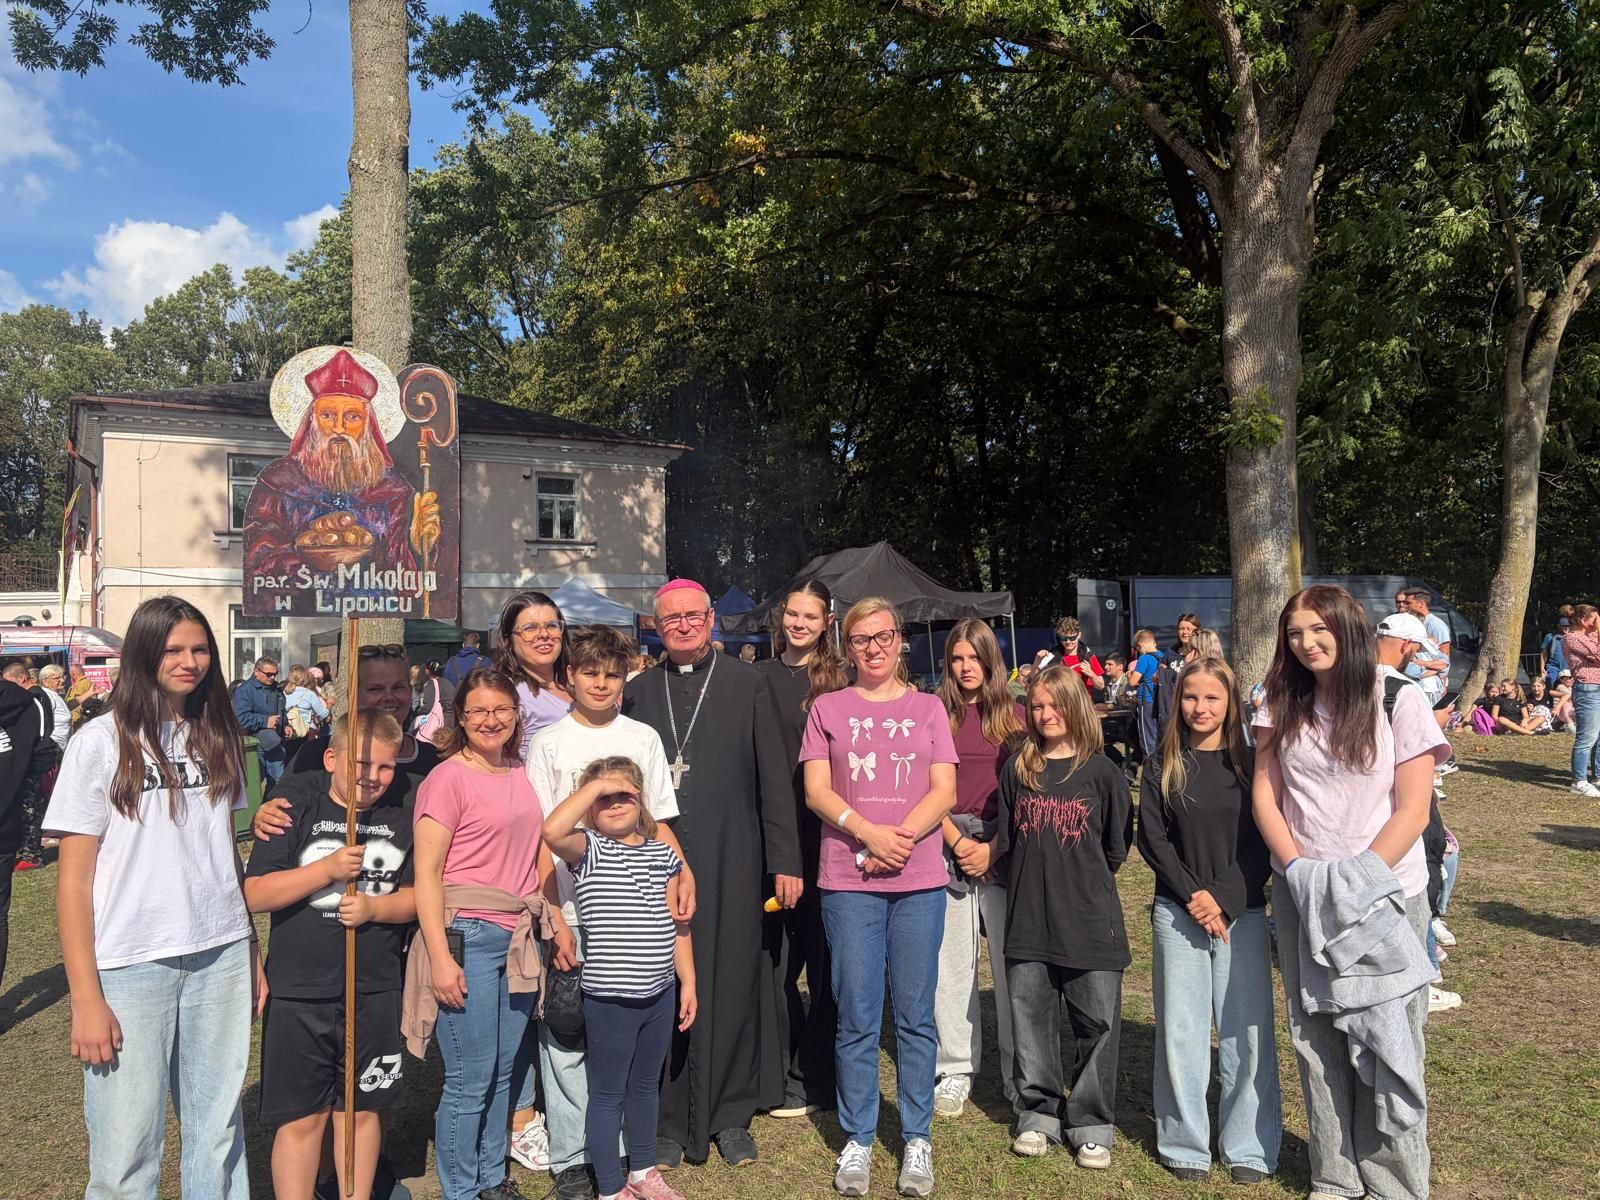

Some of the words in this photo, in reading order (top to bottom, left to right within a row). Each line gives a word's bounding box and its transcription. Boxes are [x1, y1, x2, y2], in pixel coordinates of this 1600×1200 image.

[253, 575, 290, 594] par.
[316, 590, 412, 618] Lipowcu
[359, 1052, 402, 1092] 67
[380, 1072, 403, 1080] SEVEN
